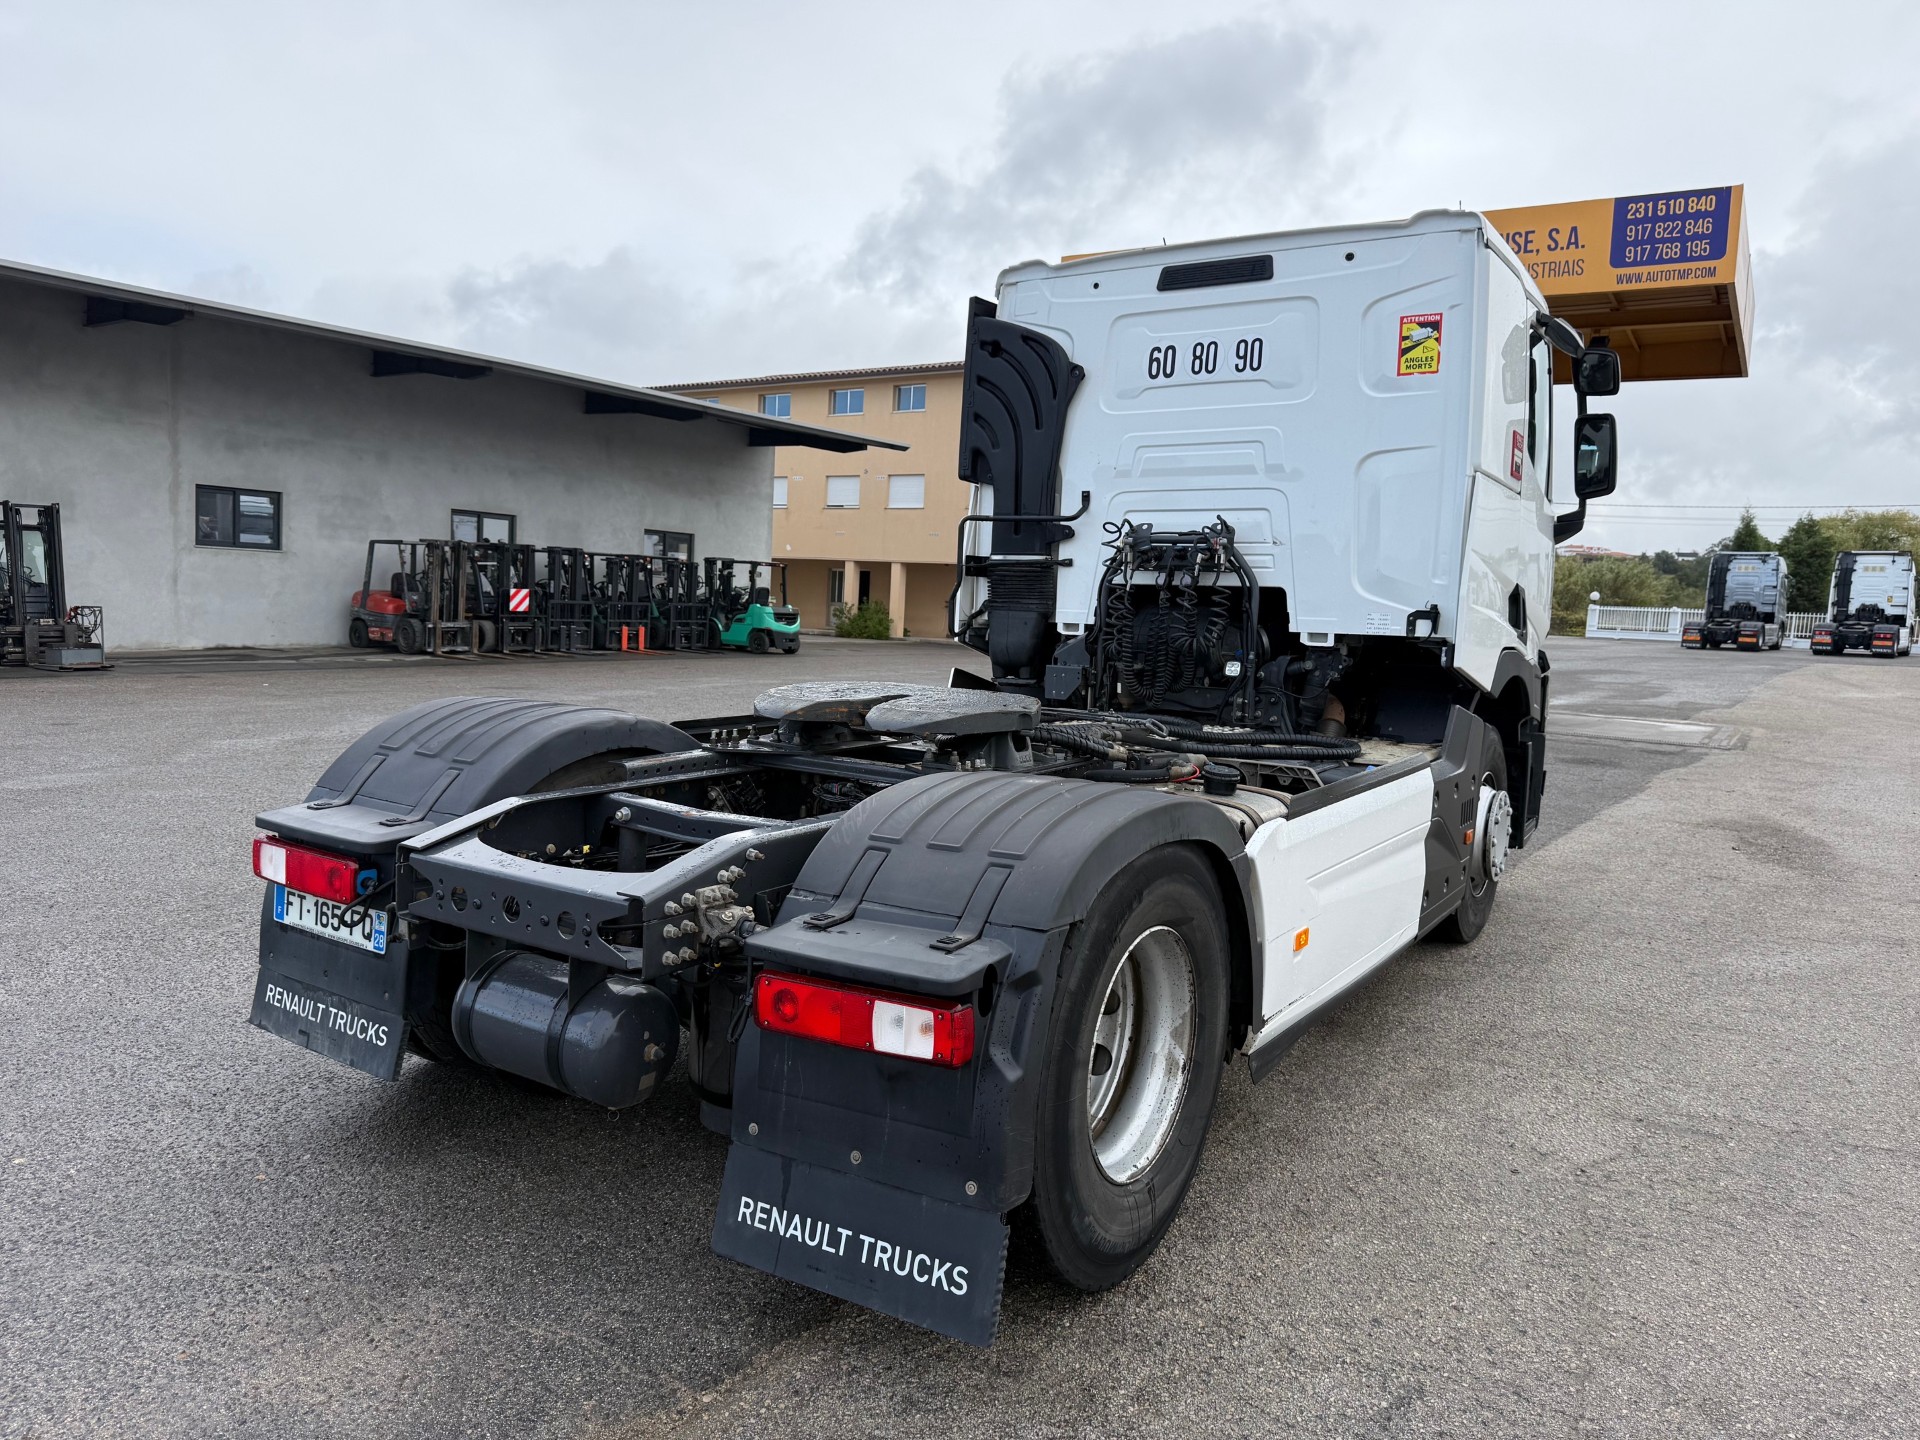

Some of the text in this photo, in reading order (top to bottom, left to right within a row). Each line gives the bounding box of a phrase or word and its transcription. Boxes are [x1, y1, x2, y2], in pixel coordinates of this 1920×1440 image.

[1627, 195, 1716, 219] 231 510 840
[1547, 225, 1586, 252] S.A.
[1626, 217, 1713, 241] 917 822 846
[1625, 239, 1710, 262] 917 768 195
[1616, 266, 1717, 285] WWW.AUTOTMP.COM
[1403, 314, 1441, 323] ATTENTION
[1147, 337, 1264, 380] 60 80 90
[1404, 355, 1435, 364] ANGLES
[1405, 362, 1433, 370] MORTS
[374, 933, 384, 948] 28
[265, 983, 389, 1047] RENAULT TRUCKS
[737, 1195, 969, 1296] RENAULT TRUCKS
